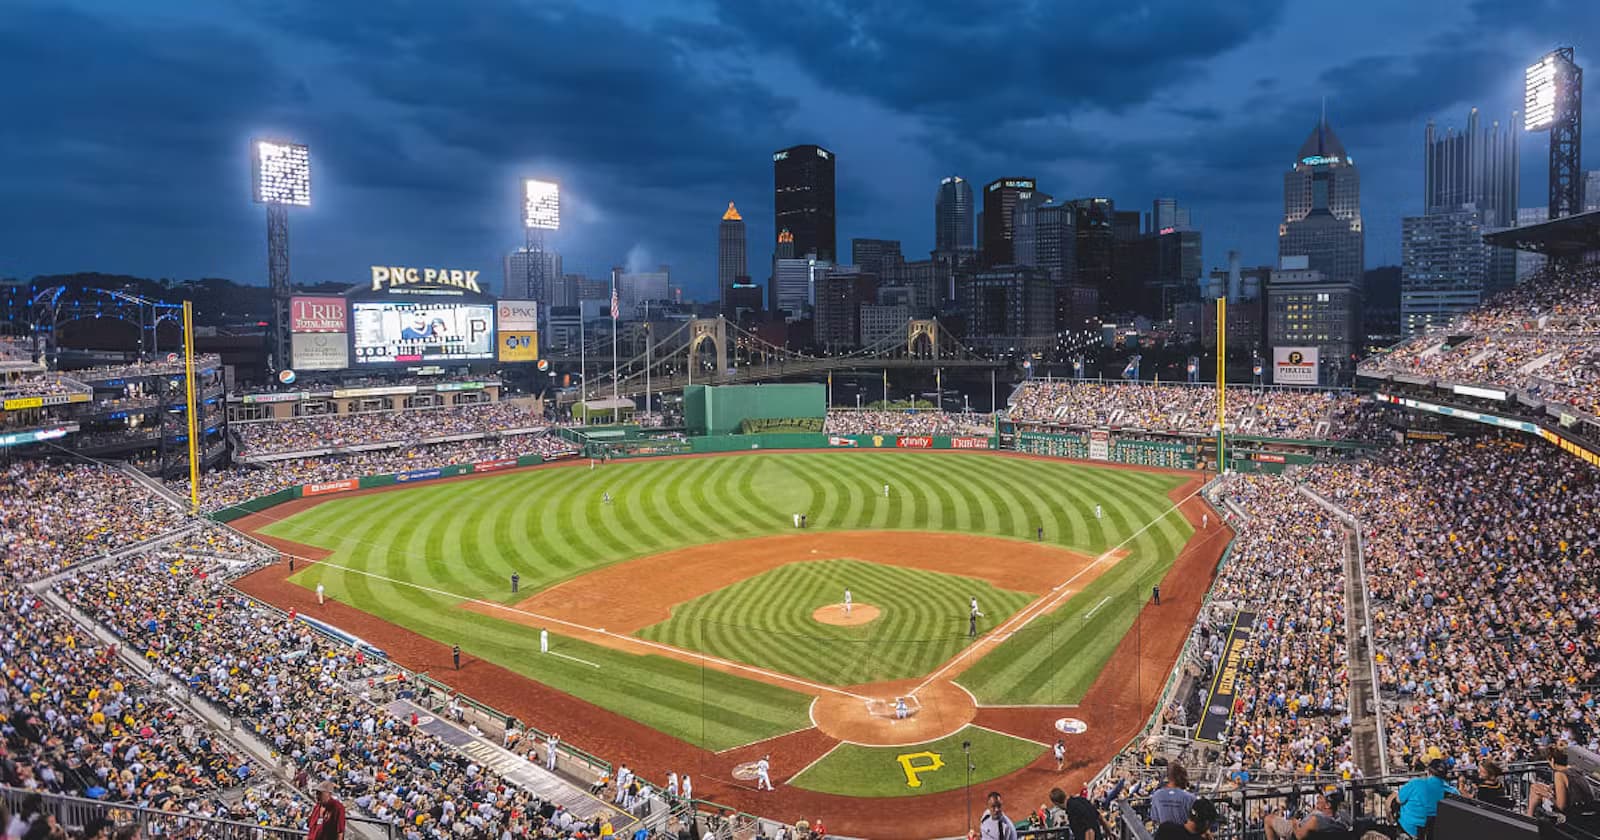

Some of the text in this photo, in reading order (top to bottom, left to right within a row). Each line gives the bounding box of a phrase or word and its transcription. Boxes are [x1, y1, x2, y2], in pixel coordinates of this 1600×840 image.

[371, 266, 481, 293] PNC PARK
[295, 301, 343, 320] TRIB
[512, 307, 535, 318] PNC
[320, 319, 344, 329] MEDIA
[900, 437, 928, 448] xfinity
[1117, 442, 1154, 450] AMERICAN
[460, 741, 520, 773] PIRATES
[897, 751, 945, 787] P
